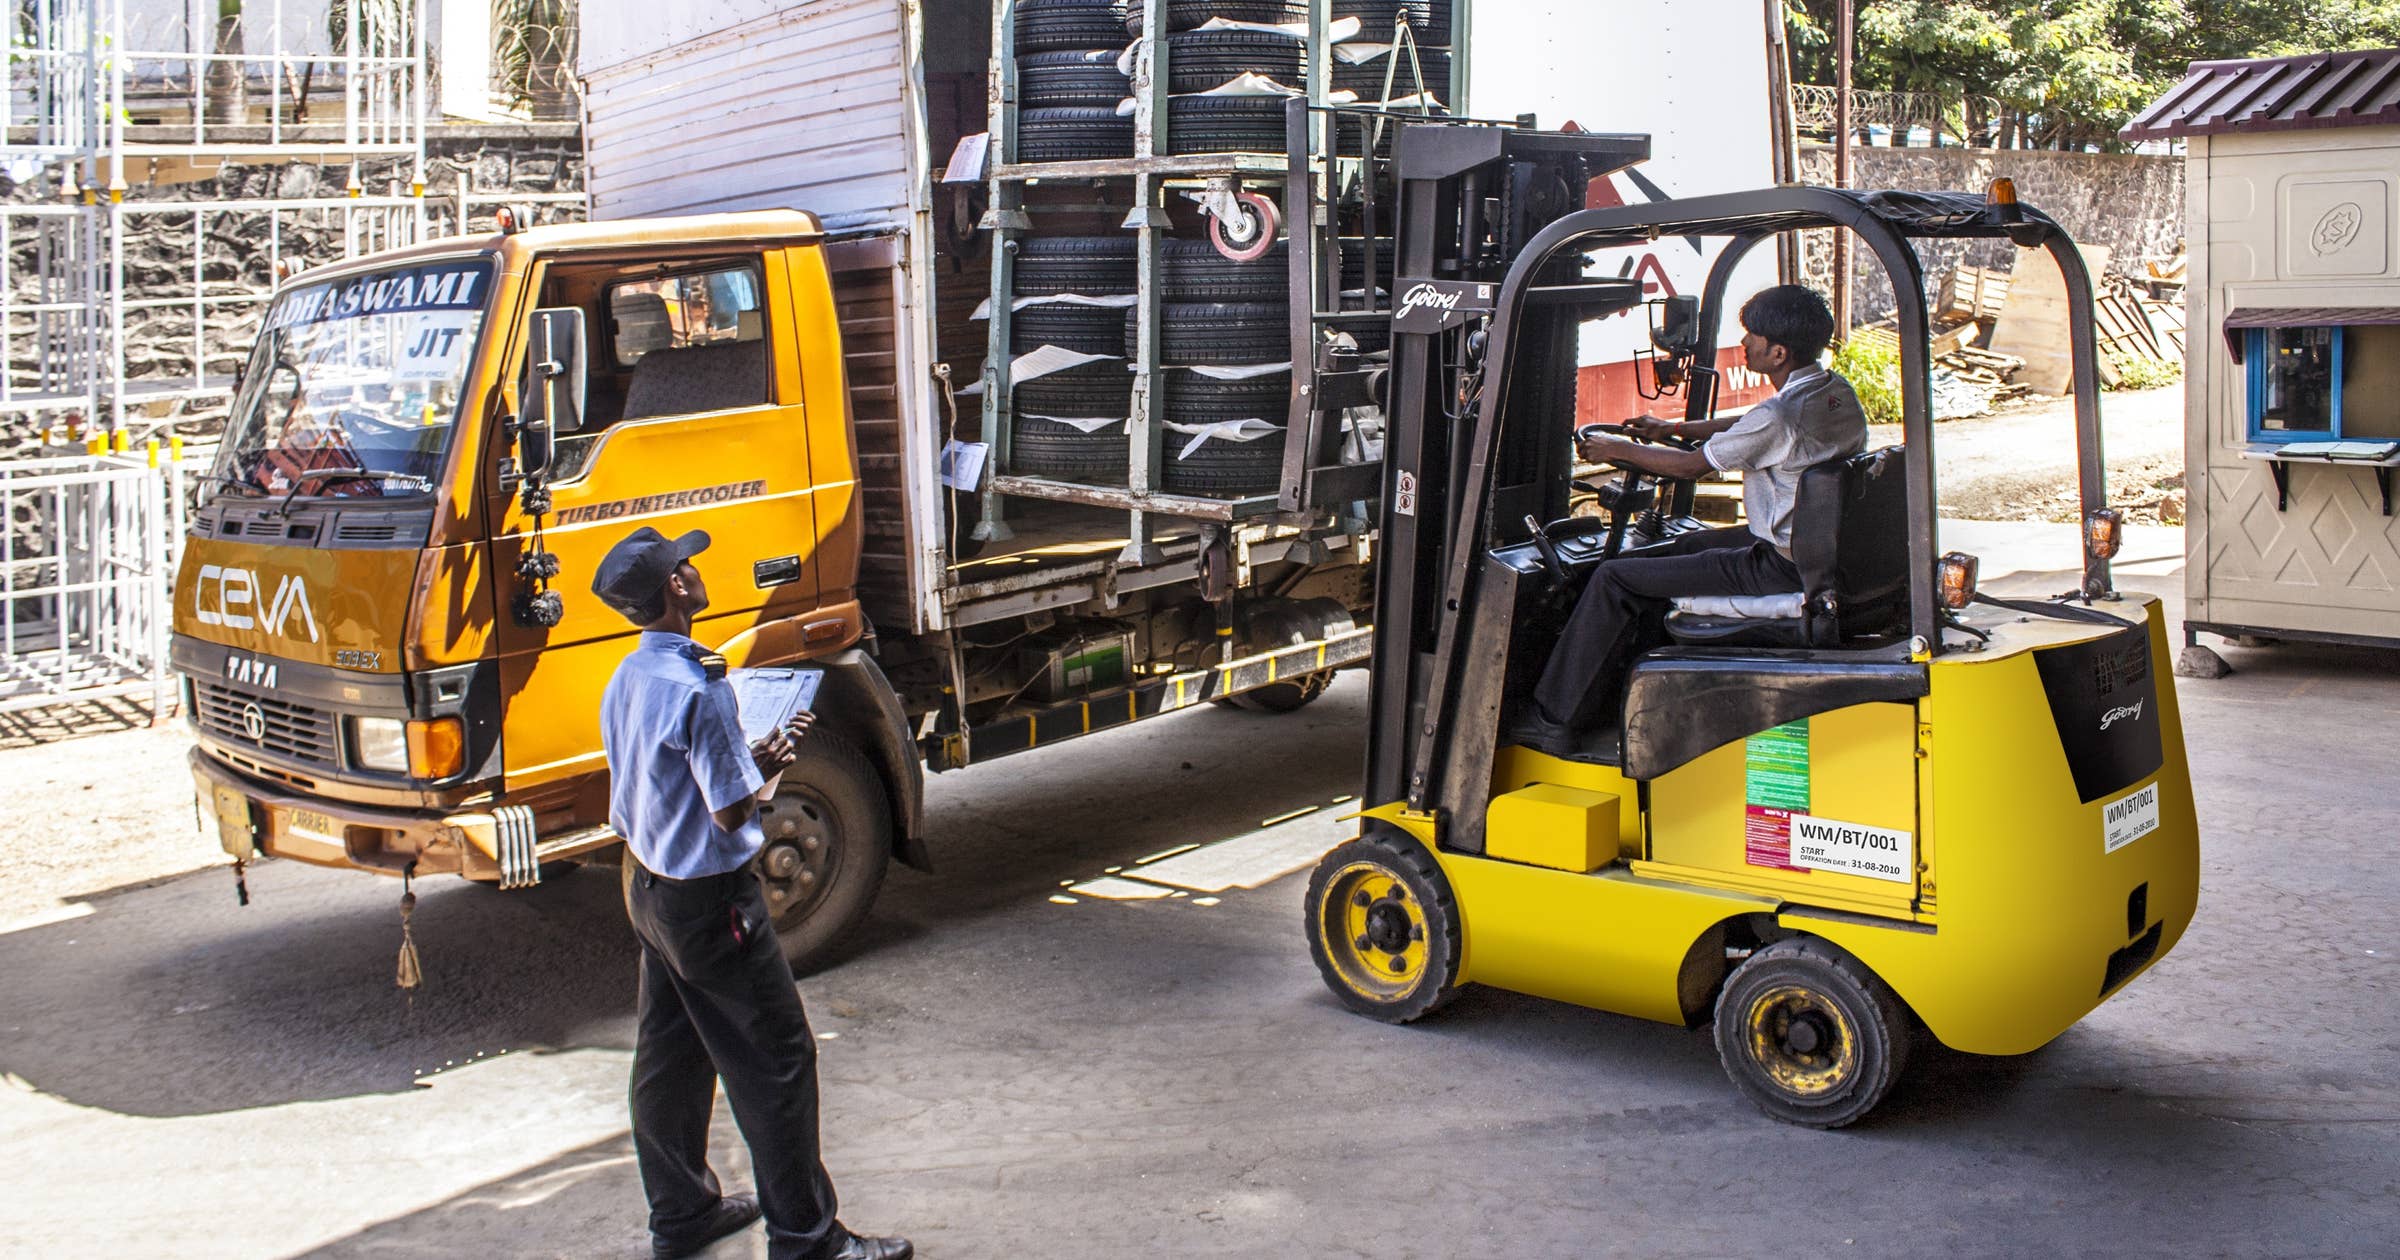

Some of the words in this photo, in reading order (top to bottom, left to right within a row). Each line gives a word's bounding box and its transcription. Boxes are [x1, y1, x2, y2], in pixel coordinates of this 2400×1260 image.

[1395, 283, 1463, 323] Godrej
[408, 327, 462, 358] JIT
[556, 501, 625, 527] TURBO
[630, 479, 763, 515] INTERCOOLER
[228, 656, 277, 689] TATA
[2100, 697, 2143, 730] Godrej
[2107, 789, 2154, 825] WM/BT/001
[1799, 823, 1898, 852] WM/BT/001
[1800, 846, 1825, 856] START
[1851, 859, 1901, 875] 31-08-2010
